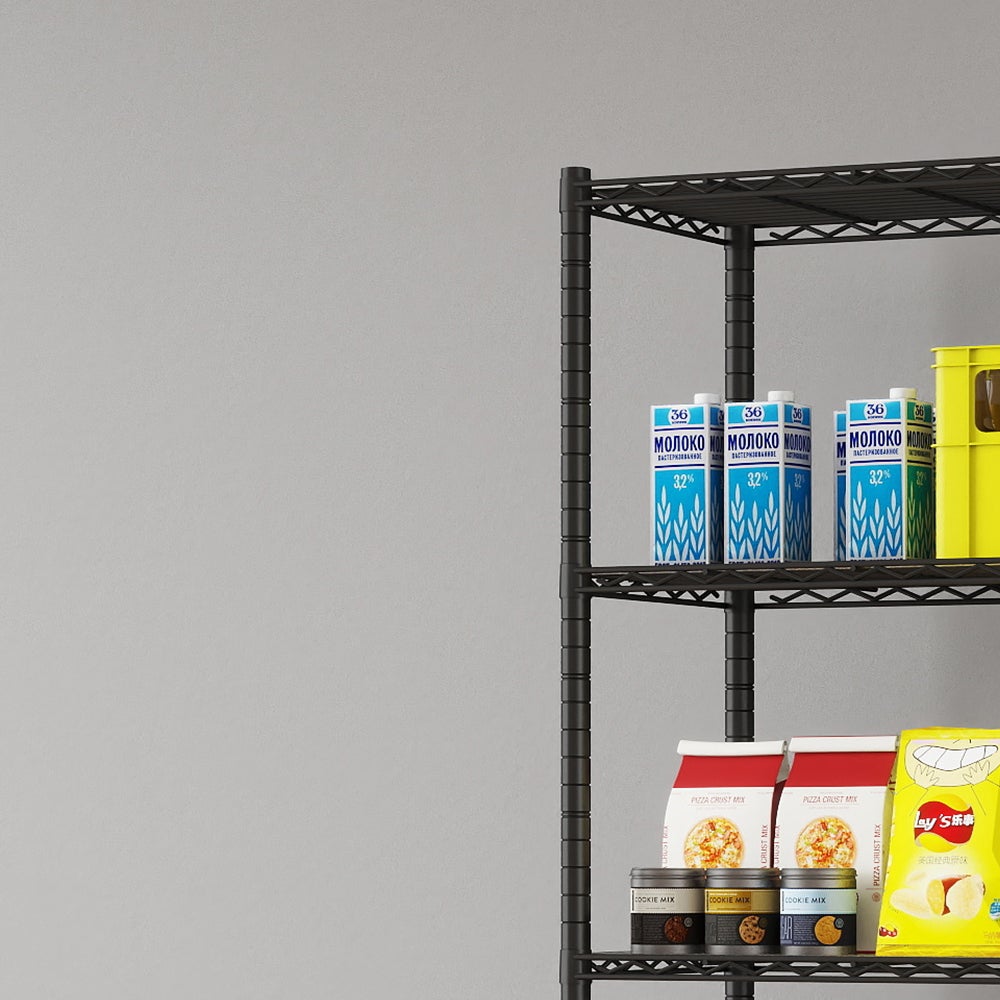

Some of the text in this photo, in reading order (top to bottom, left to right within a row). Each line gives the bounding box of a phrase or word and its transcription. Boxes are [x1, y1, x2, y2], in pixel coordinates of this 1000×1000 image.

[671, 409, 688, 420] 36
[745, 406, 762, 417] 36
[866, 404, 884, 415] 36
[654, 434, 705, 453] МОЛОКО
[728, 432, 779, 451] МОЛОКО
[850, 430, 901, 448] МОЛОКО
[873, 824, 881, 838] MIX
[873, 840, 881, 864] CRUST
